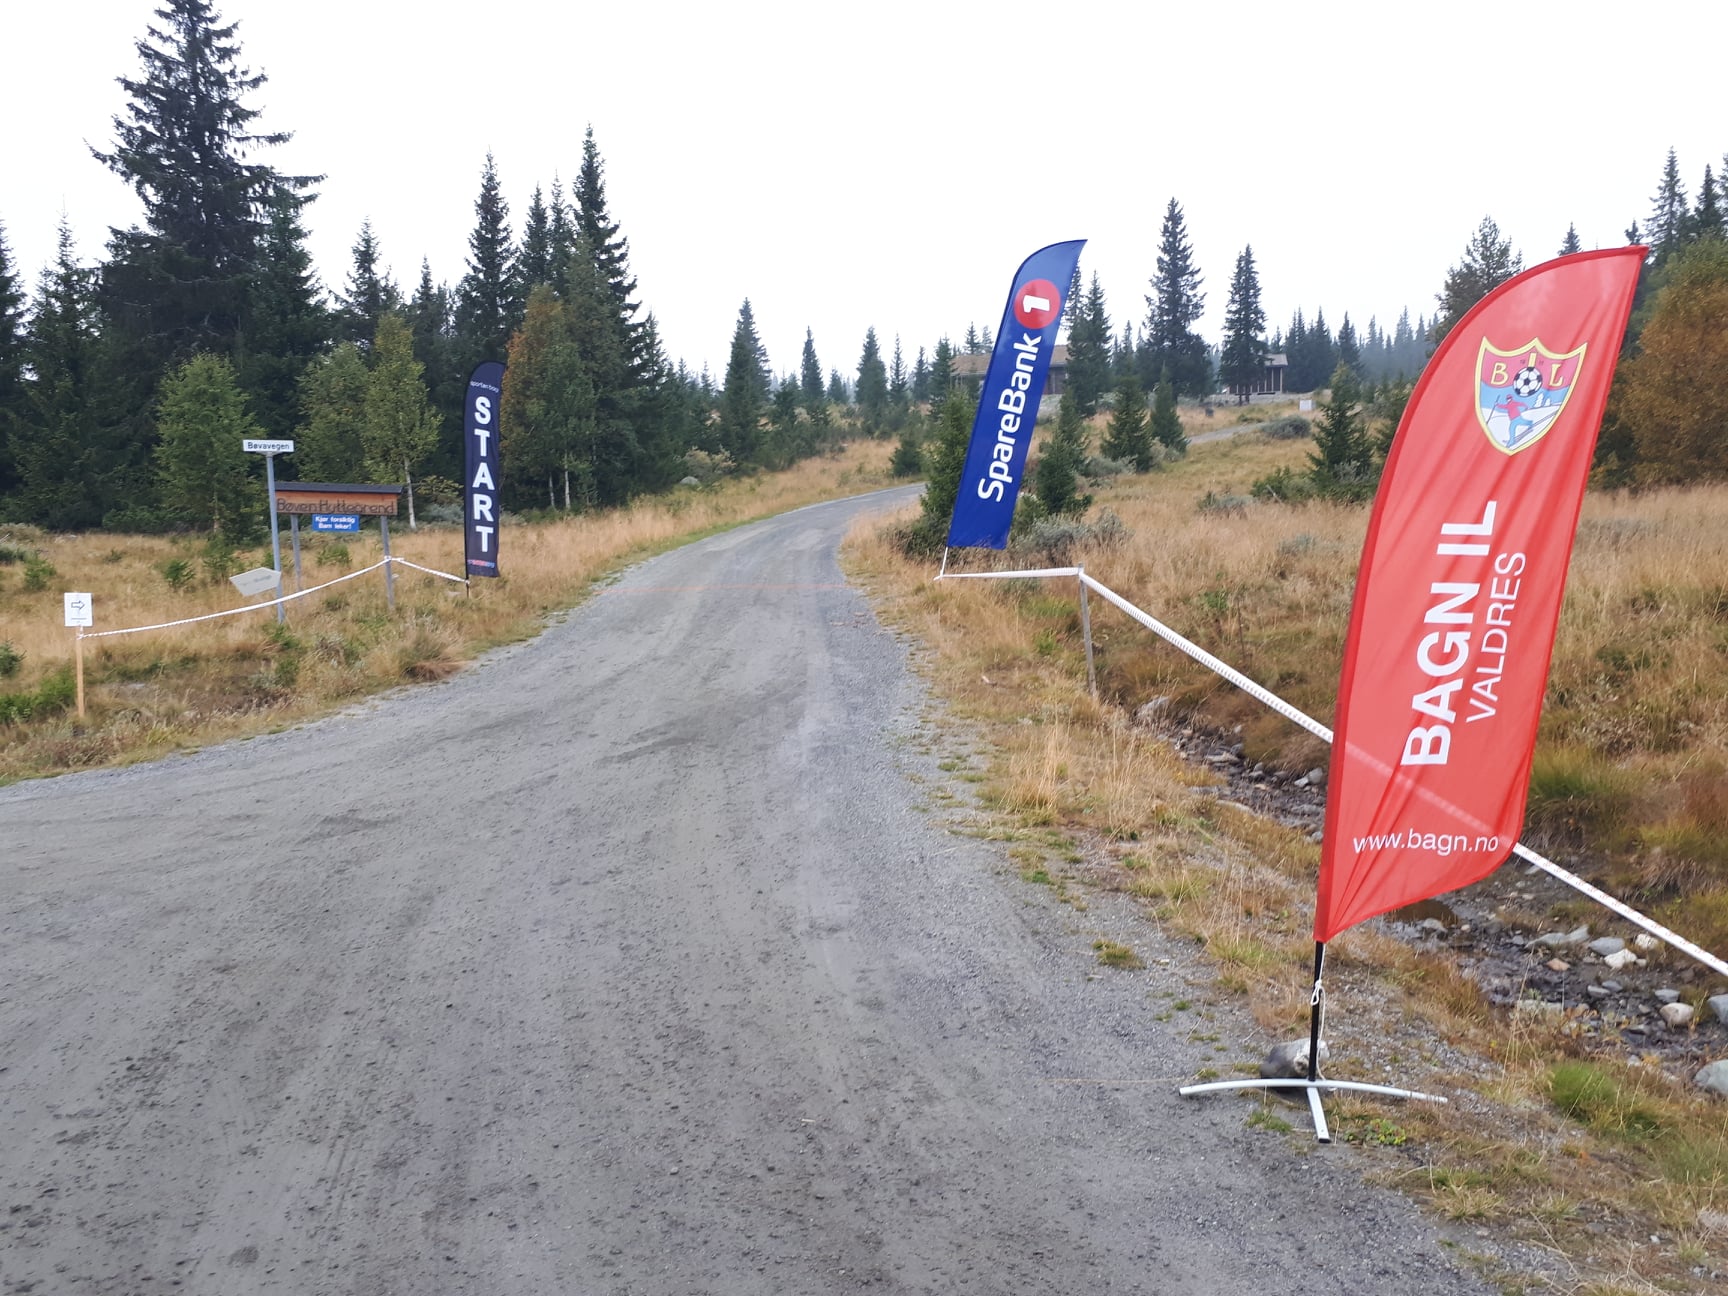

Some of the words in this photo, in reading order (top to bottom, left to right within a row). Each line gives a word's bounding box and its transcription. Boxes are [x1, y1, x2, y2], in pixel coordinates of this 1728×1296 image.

[472, 395, 495, 553] START
[977, 332, 1042, 503] SpareBank
[1022, 294, 1050, 313] 1
[1436, 500, 1497, 556] IL
[1400, 582, 1481, 766] BAGN
[1465, 551, 1526, 723] VALDRES
[1352, 827, 1500, 857] www.bagn.no
